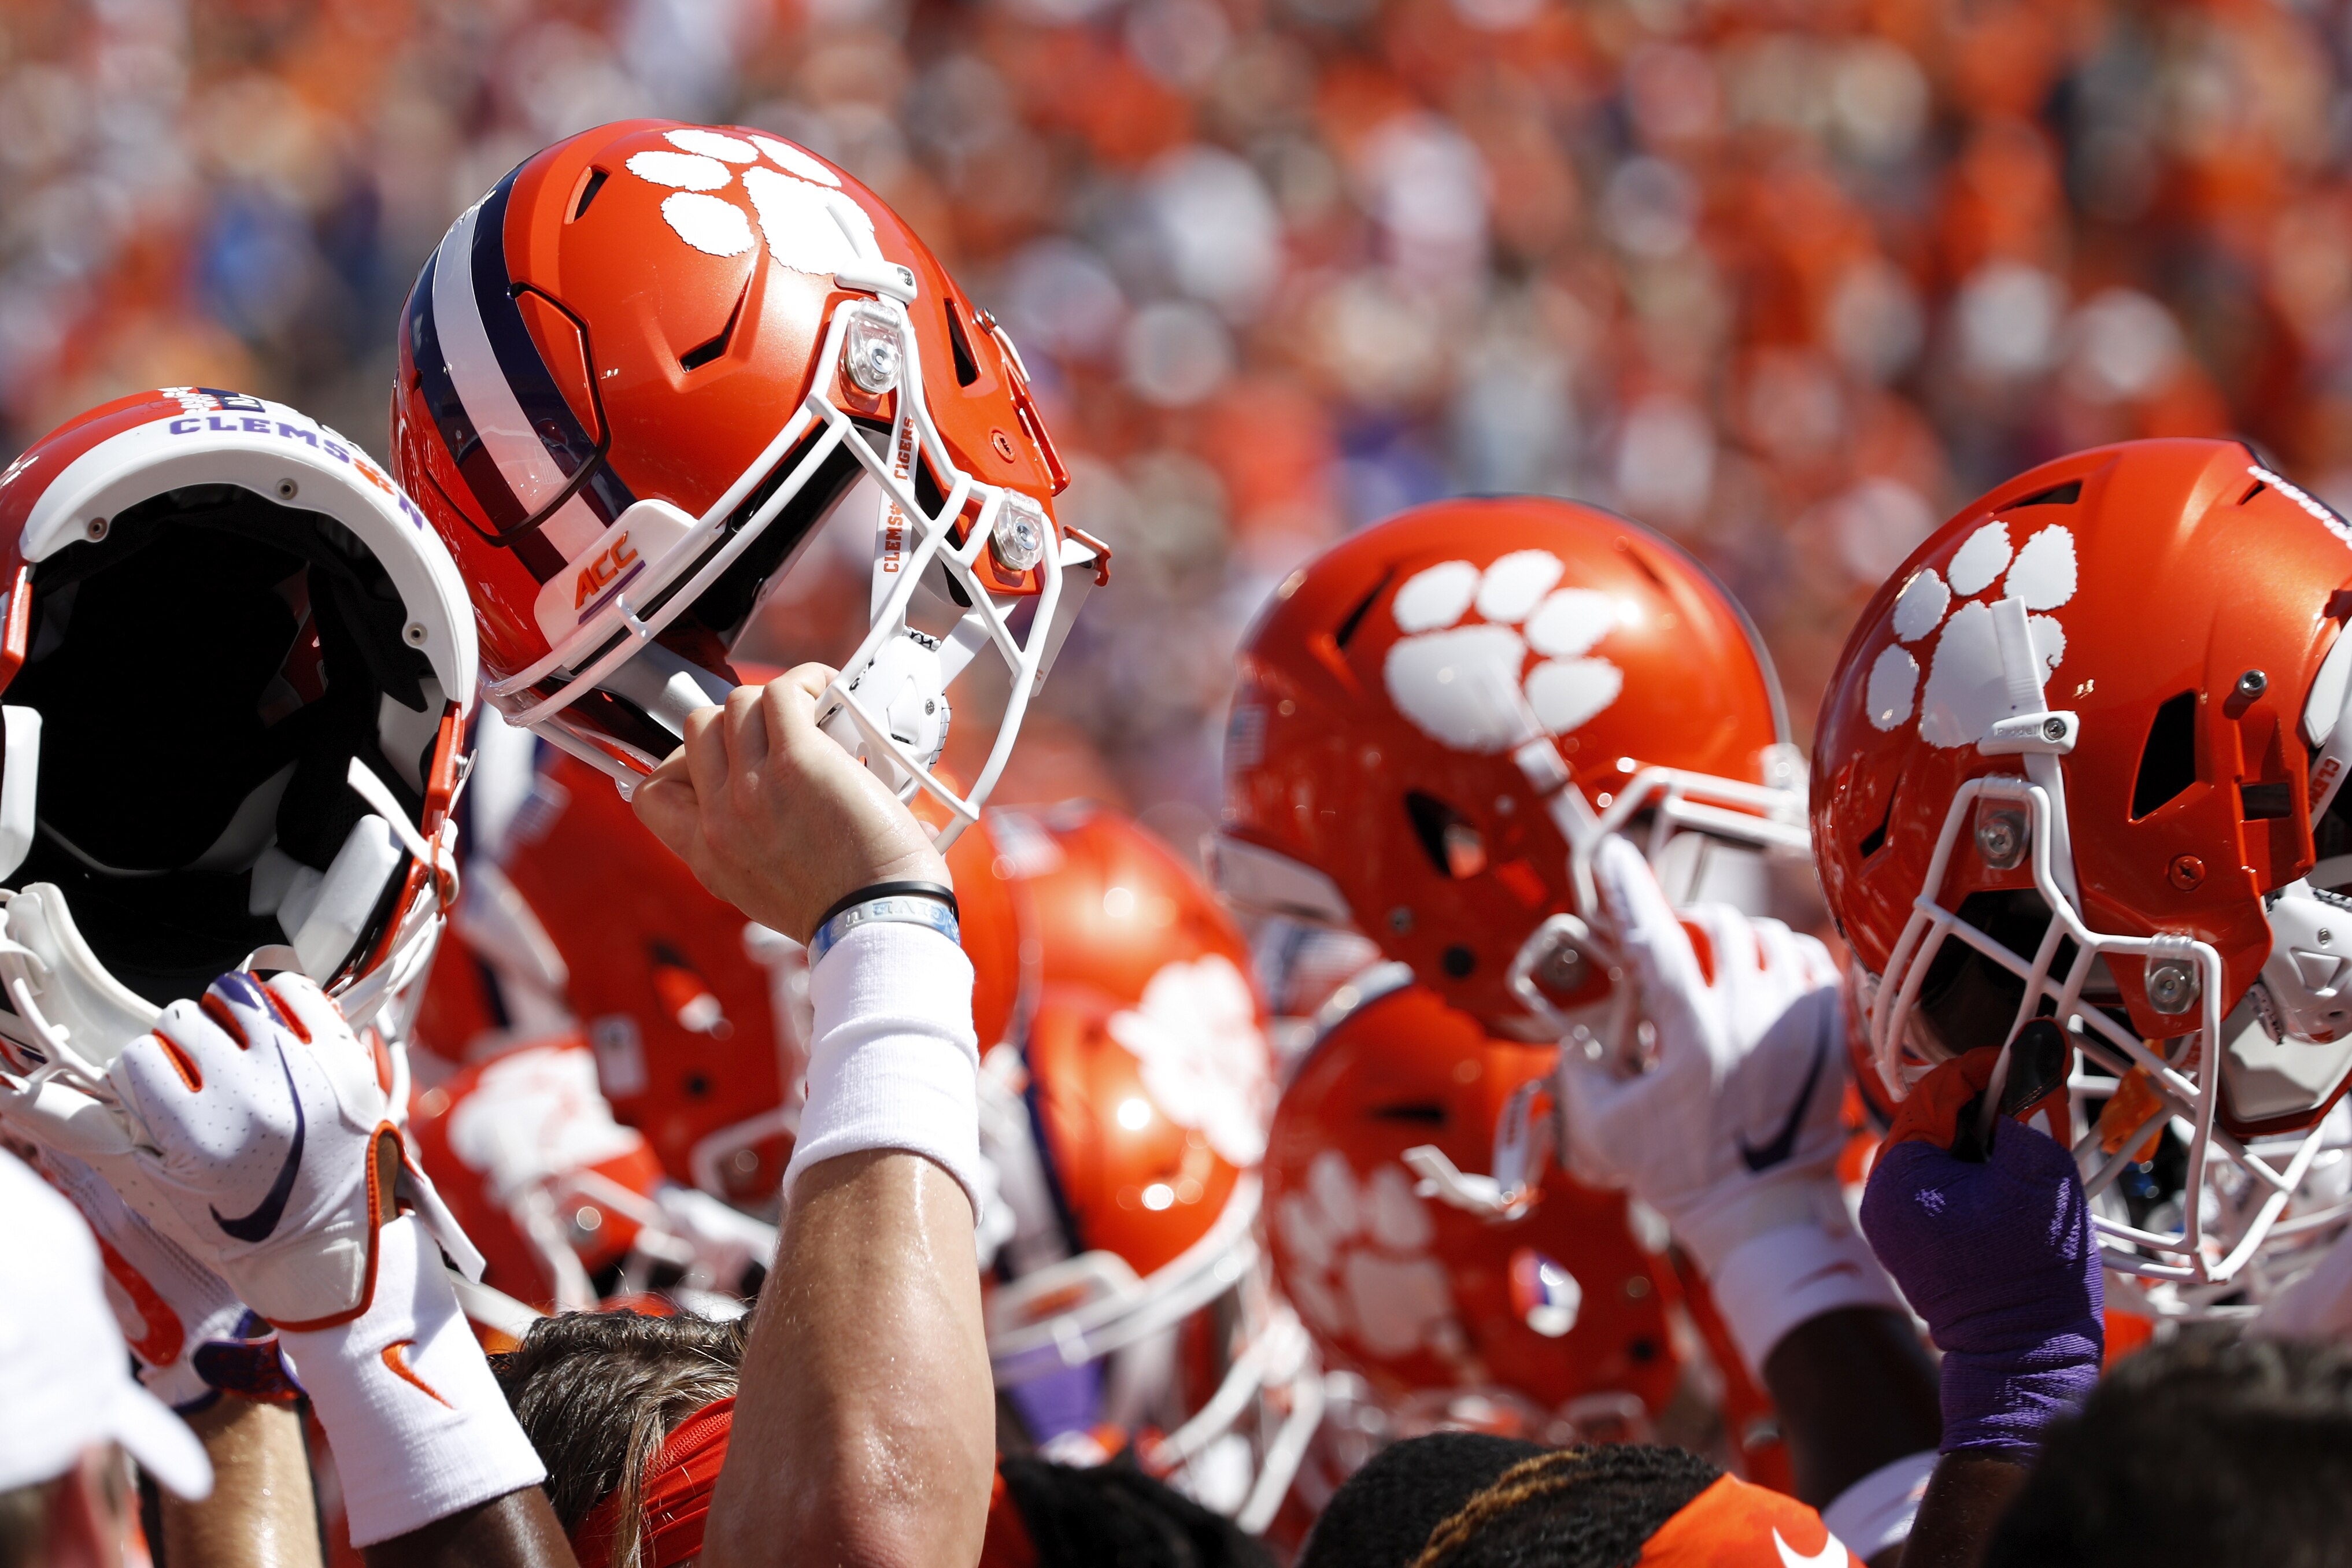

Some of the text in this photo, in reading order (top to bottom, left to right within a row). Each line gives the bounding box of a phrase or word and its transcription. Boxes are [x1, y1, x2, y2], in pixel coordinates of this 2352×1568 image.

[883, 416, 914, 573] CLEMS TIGERS
[575, 530, 638, 611] ACC
[1994, 724, 2041, 737] Rddell
[2309, 758, 2340, 813] CLEM
